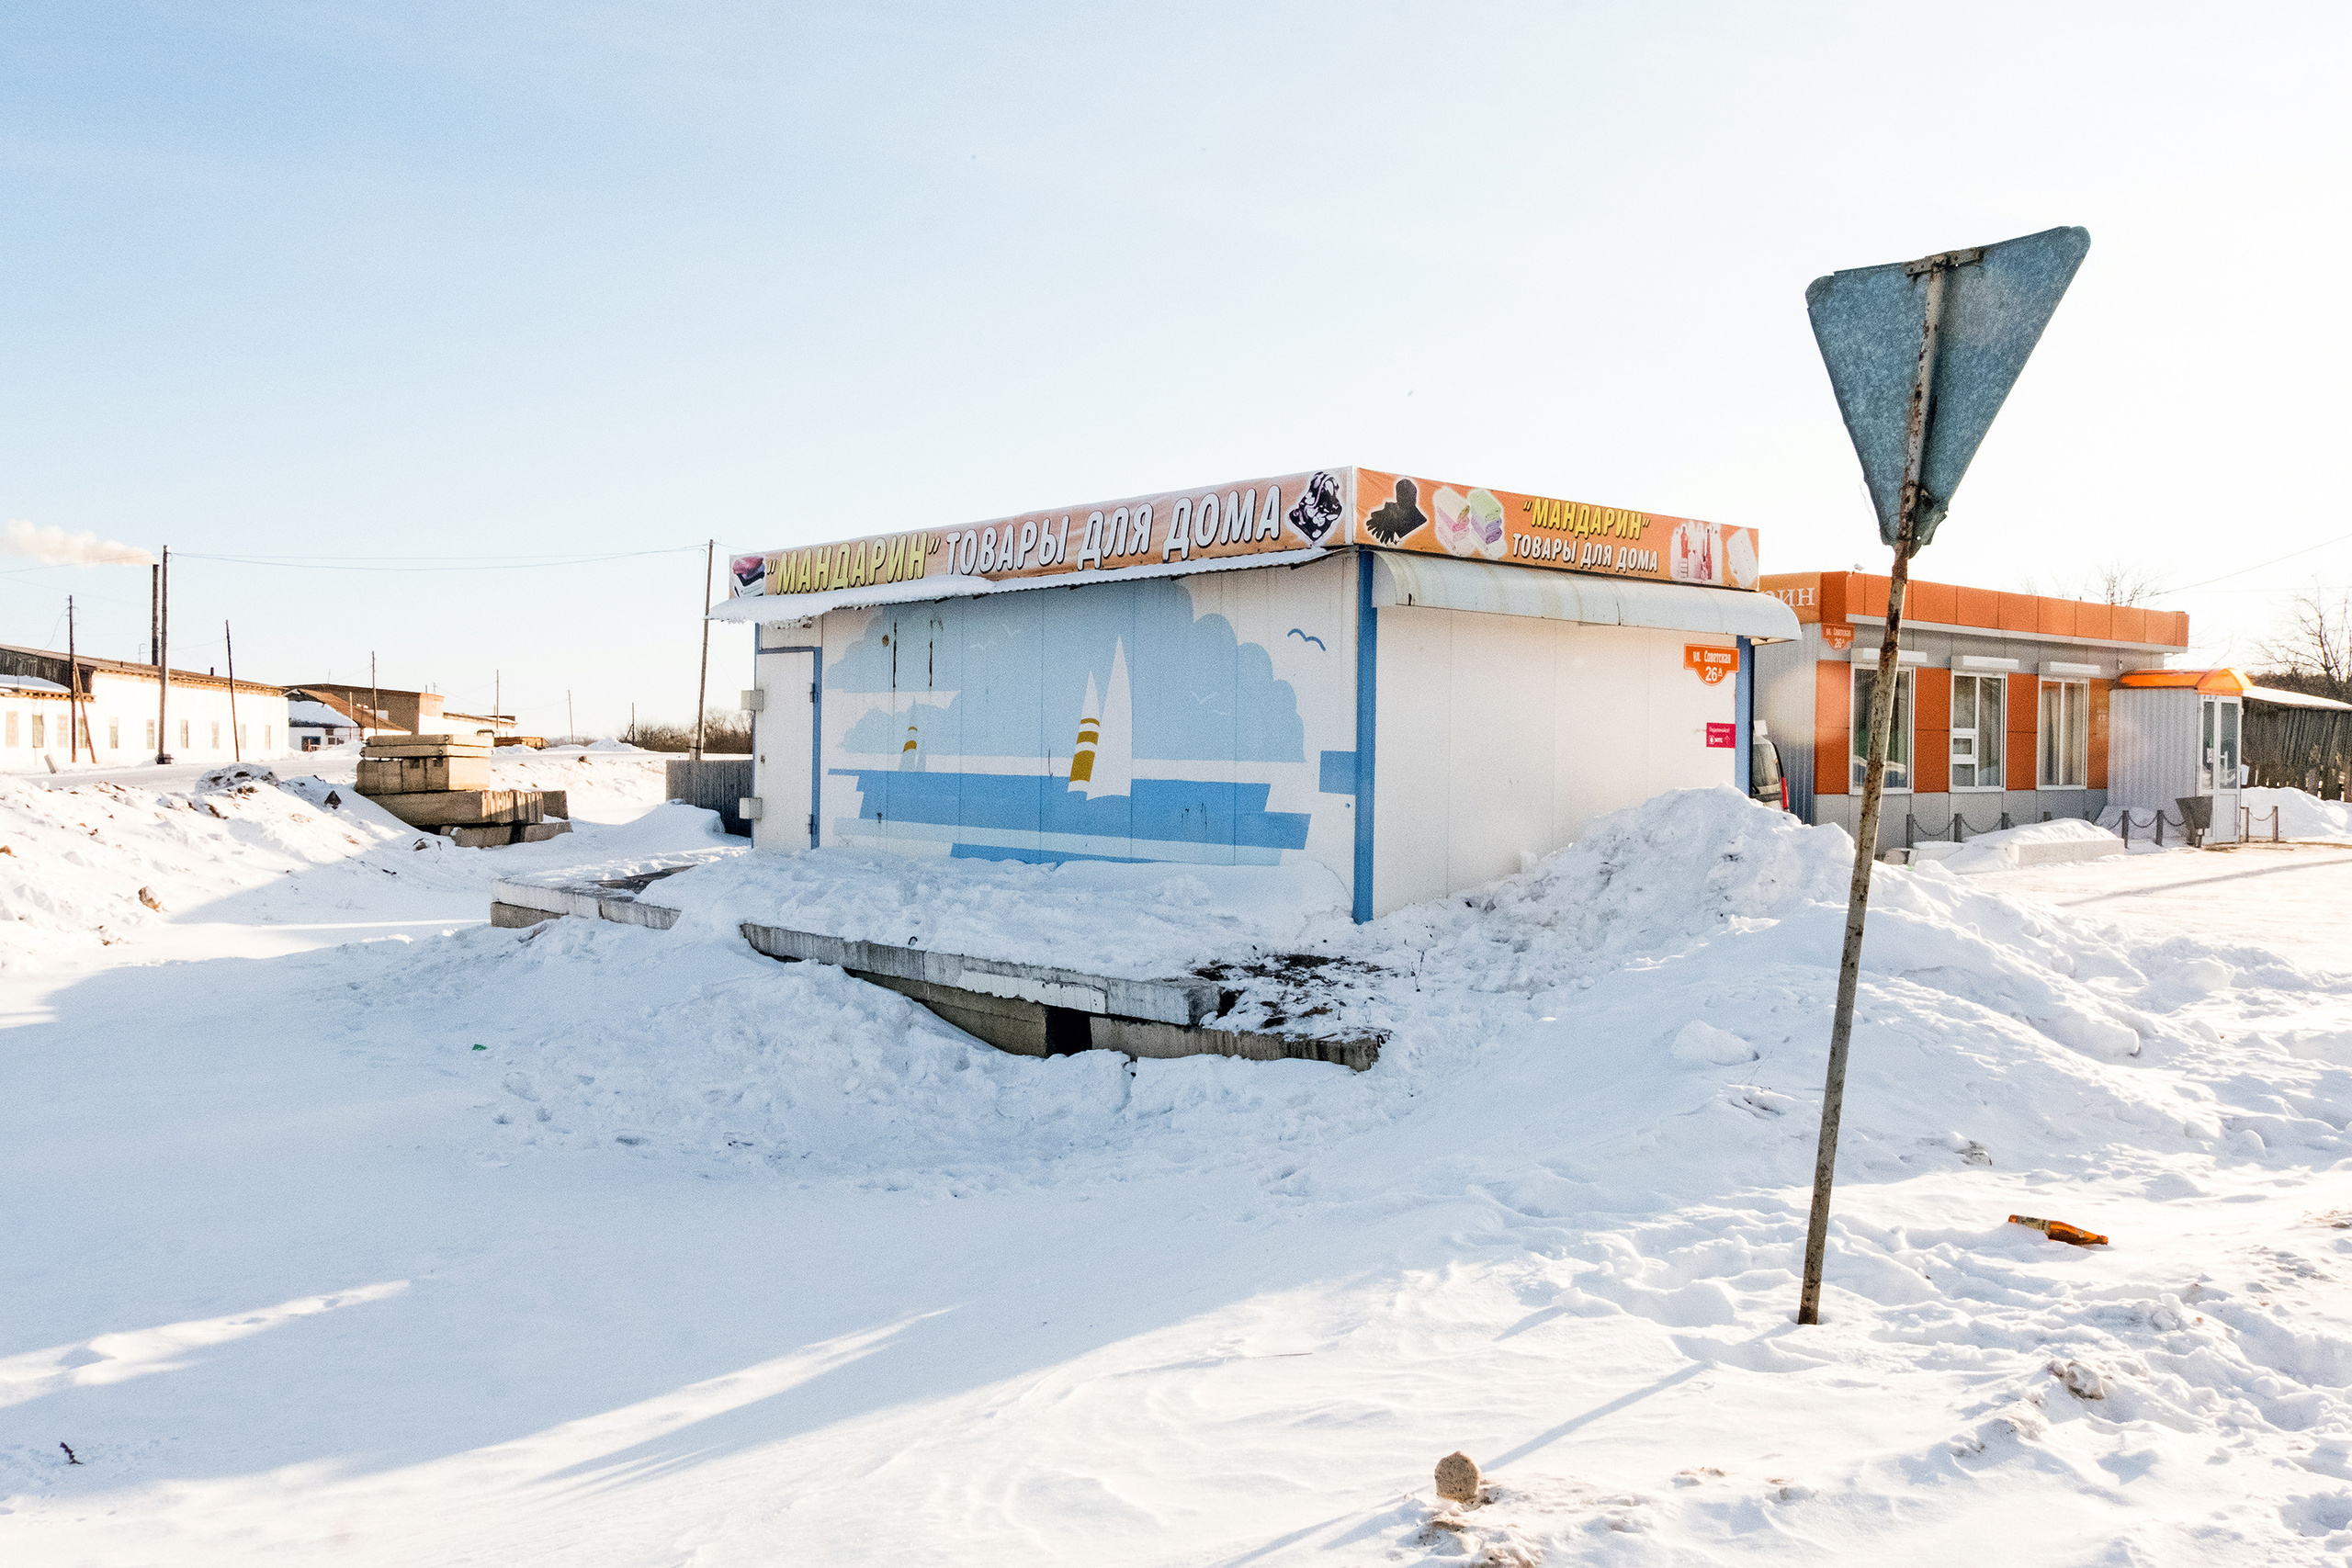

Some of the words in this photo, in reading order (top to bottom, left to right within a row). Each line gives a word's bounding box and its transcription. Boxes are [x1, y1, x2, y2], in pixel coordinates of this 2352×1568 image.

[946, 514, 1070, 575] ТОВАРЫ
[1077, 502, 1154, 571] ДЛЯ
[1162, 485, 1281, 563] ДОМА
[1513, 533, 1578, 562] ТОВАРЫ
[1579, 541, 1613, 569] ДЛЯ
[1615, 546, 1658, 572] ДОМА
